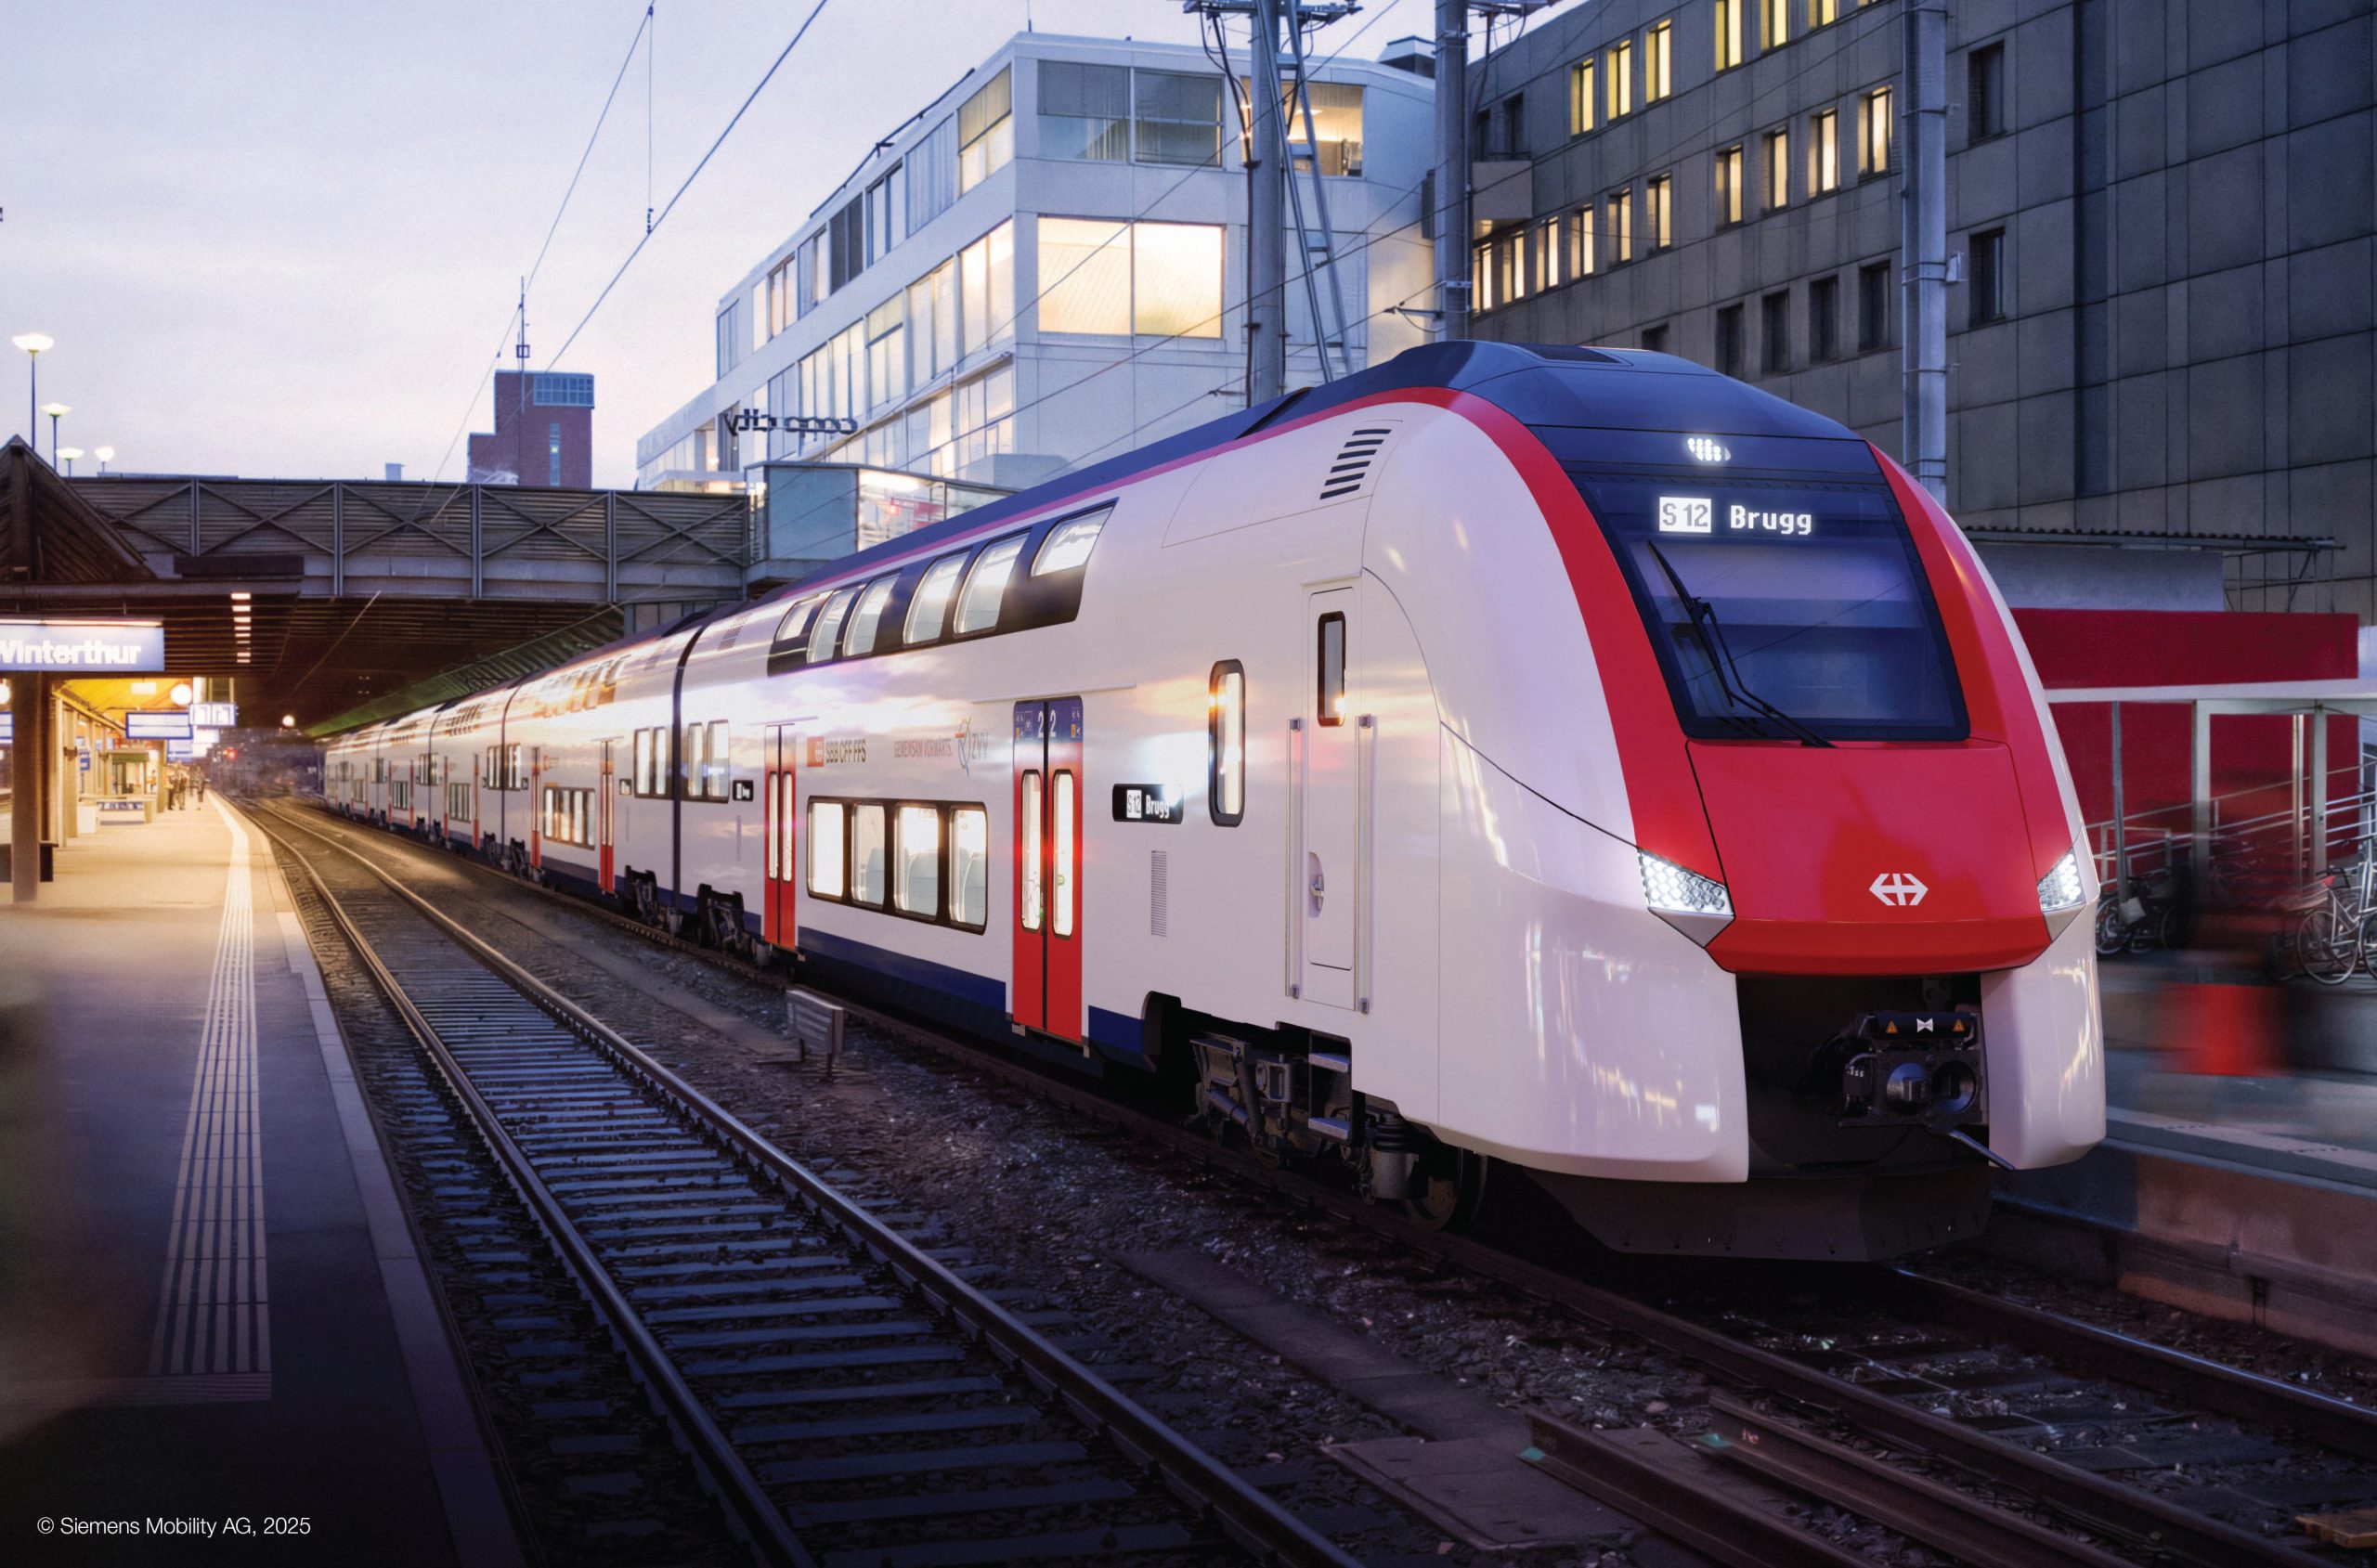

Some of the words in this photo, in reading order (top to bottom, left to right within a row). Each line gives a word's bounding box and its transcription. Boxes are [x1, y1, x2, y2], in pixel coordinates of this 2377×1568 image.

[1730, 505, 1812, 536] Brugg
[1037, 710, 1045, 738] 2
[1049, 709, 1057, 738] 2
[825, 740, 838, 763] SBB
[839, 739, 852, 763] CFF
[853, 738, 866, 763] FFS
[1146, 795, 1170, 819] Brugg
